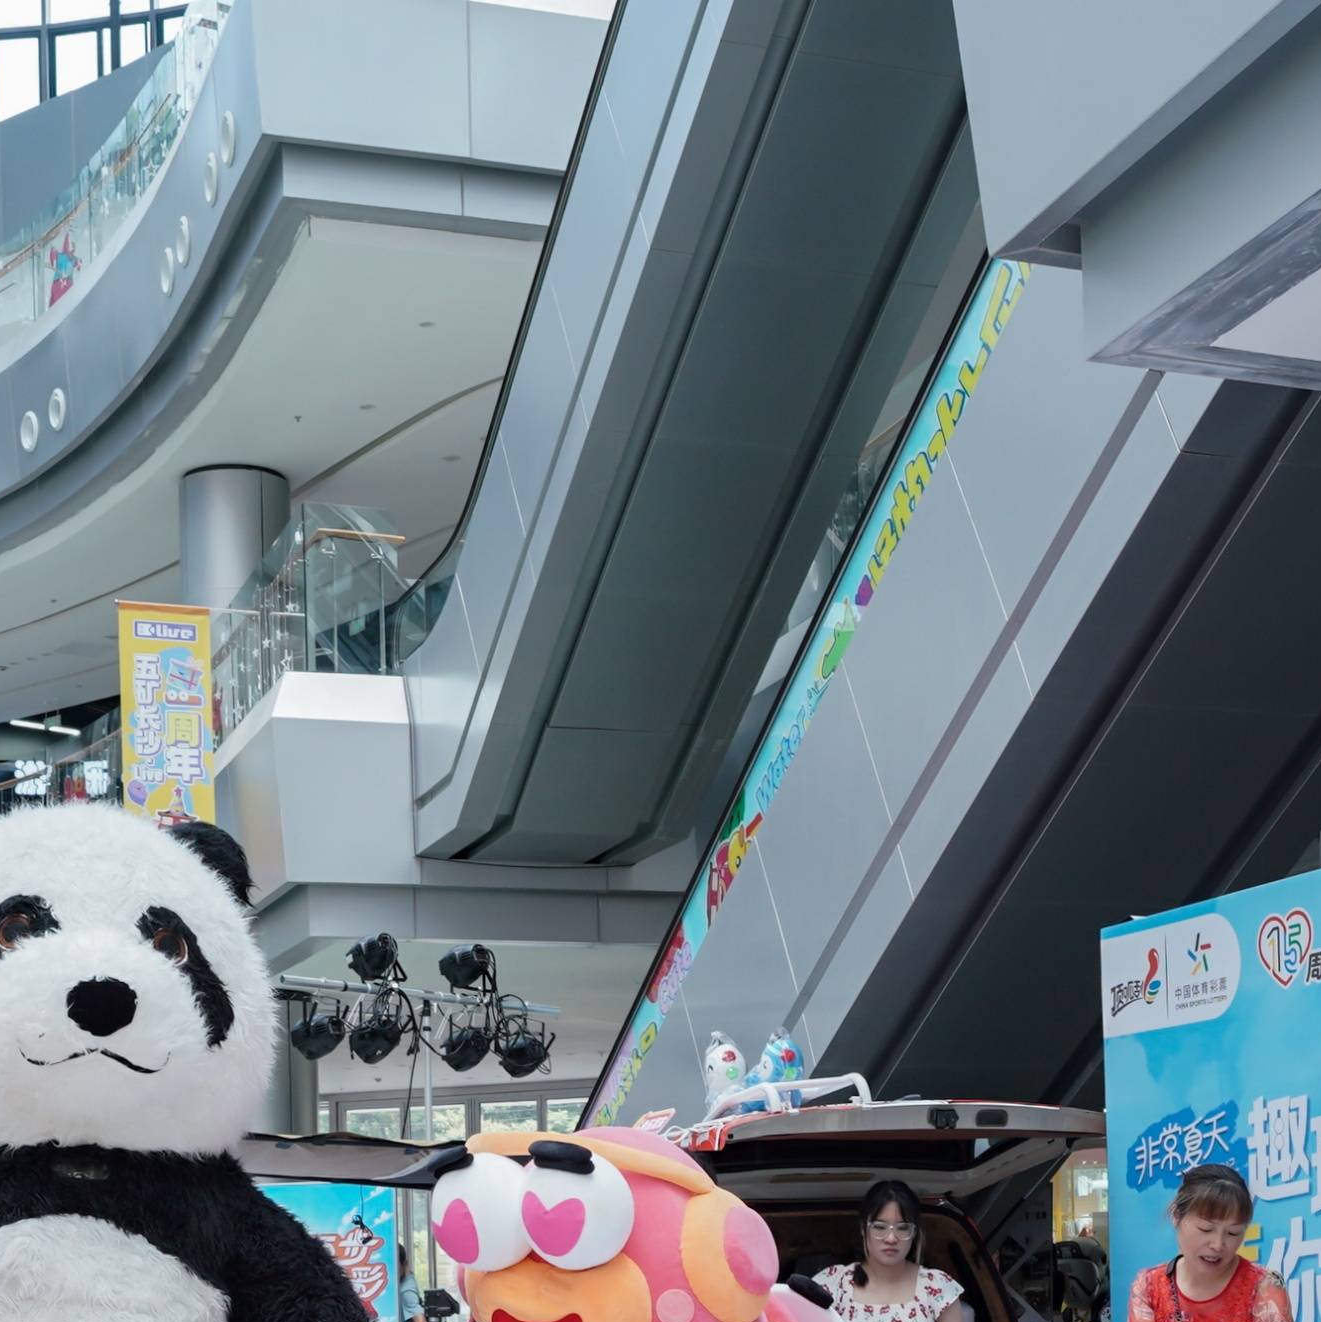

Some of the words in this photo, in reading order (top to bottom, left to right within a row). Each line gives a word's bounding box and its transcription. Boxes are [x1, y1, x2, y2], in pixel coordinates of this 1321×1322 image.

[1266, 921, 1302, 974] 15
[1174, 976, 1228, 1001] 中国体育彩票
[1134, 1110, 1230, 1185] 非常夏天
